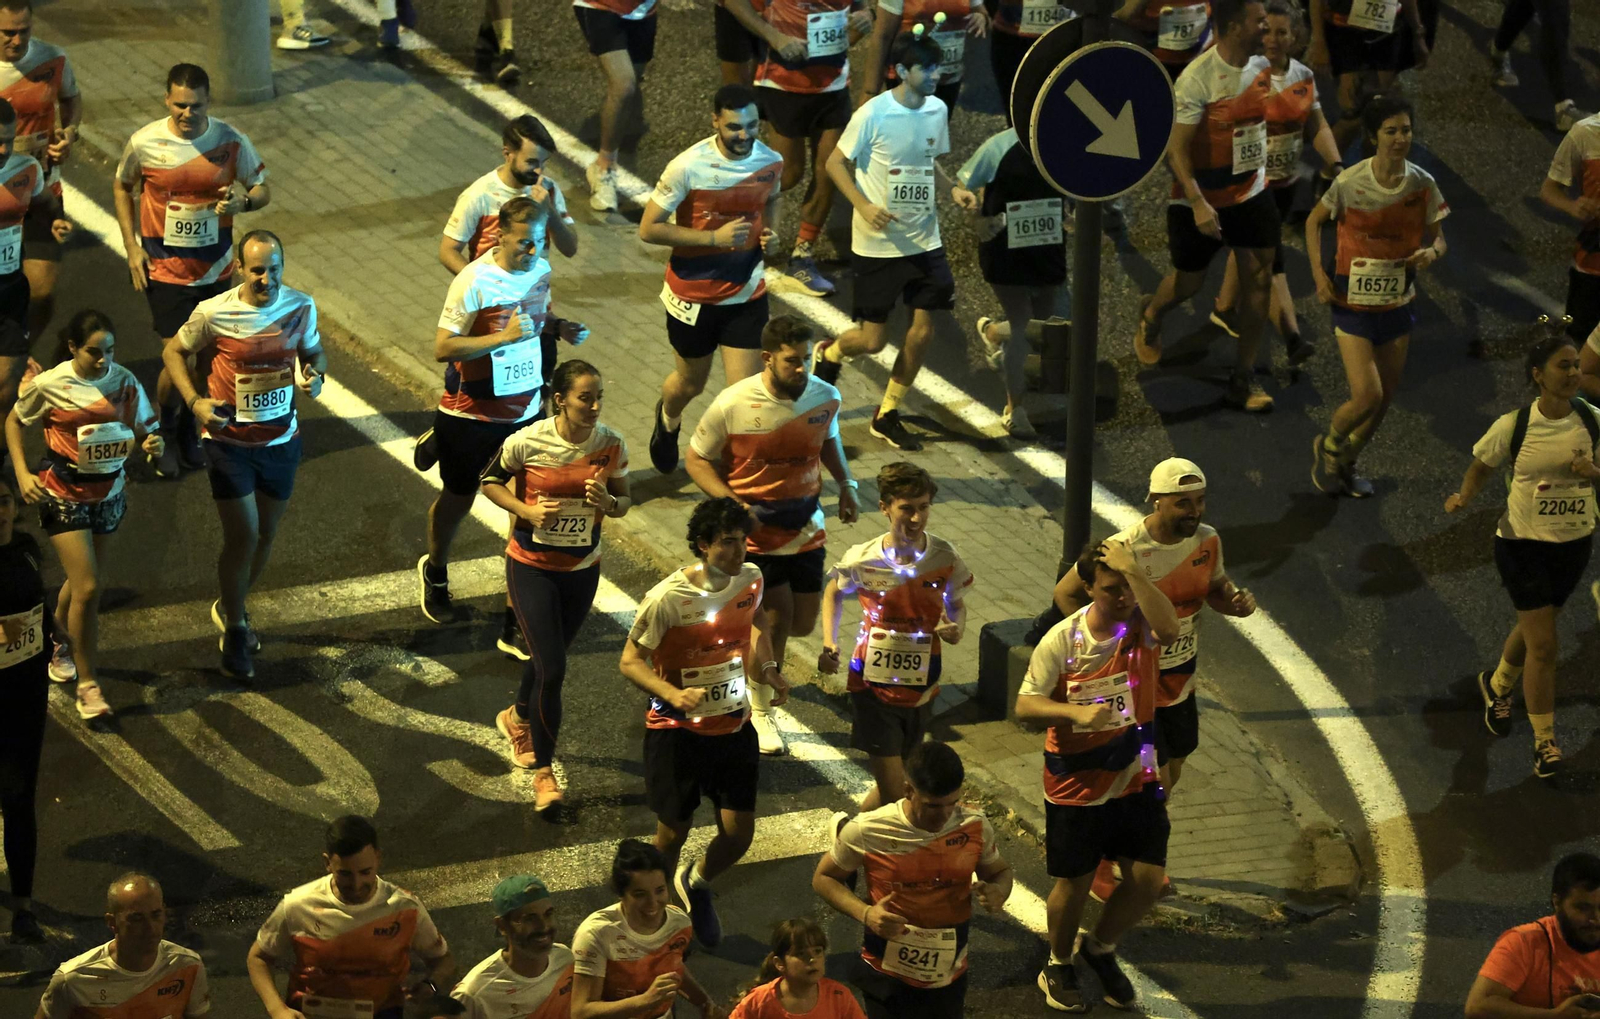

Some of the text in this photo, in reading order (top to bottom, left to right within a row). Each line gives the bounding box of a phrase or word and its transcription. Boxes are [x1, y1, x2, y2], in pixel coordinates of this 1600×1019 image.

[1364, 2, 1386, 19] 782
[1173, 23, 1194, 39] 787
[893, 185, 929, 201] 16186
[175, 220, 208, 236] 9921
[1014, 217, 1055, 235] 16190
[1356, 277, 1399, 293] 16572
[504, 360, 535, 381] 7869
[243, 389, 287, 409] 15880
[86, 441, 129, 461] 15874
[1538, 499, 1586, 516] 22042
[544, 517, 588, 533] 2723
[872, 650, 922, 671] 21959
[899, 946, 940, 968] 6241
